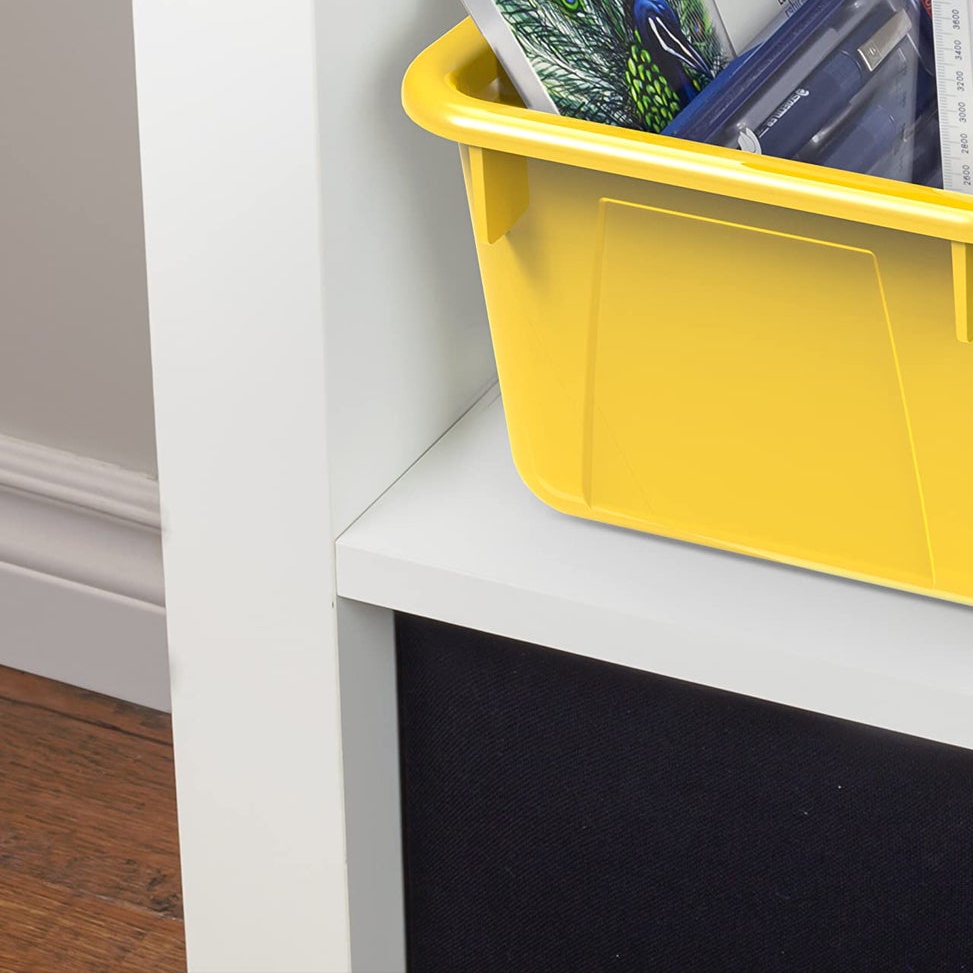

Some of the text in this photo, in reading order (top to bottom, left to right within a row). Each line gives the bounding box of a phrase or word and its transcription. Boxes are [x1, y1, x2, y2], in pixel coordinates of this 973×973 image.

[952, 9, 960, 30] 3600
[954, 40, 962, 60] 3400
[956, 70, 964, 92] 3200
[958, 101, 966, 122] 3000
[960, 133, 969, 154] 2800
[964, 164, 972, 186] 2600
